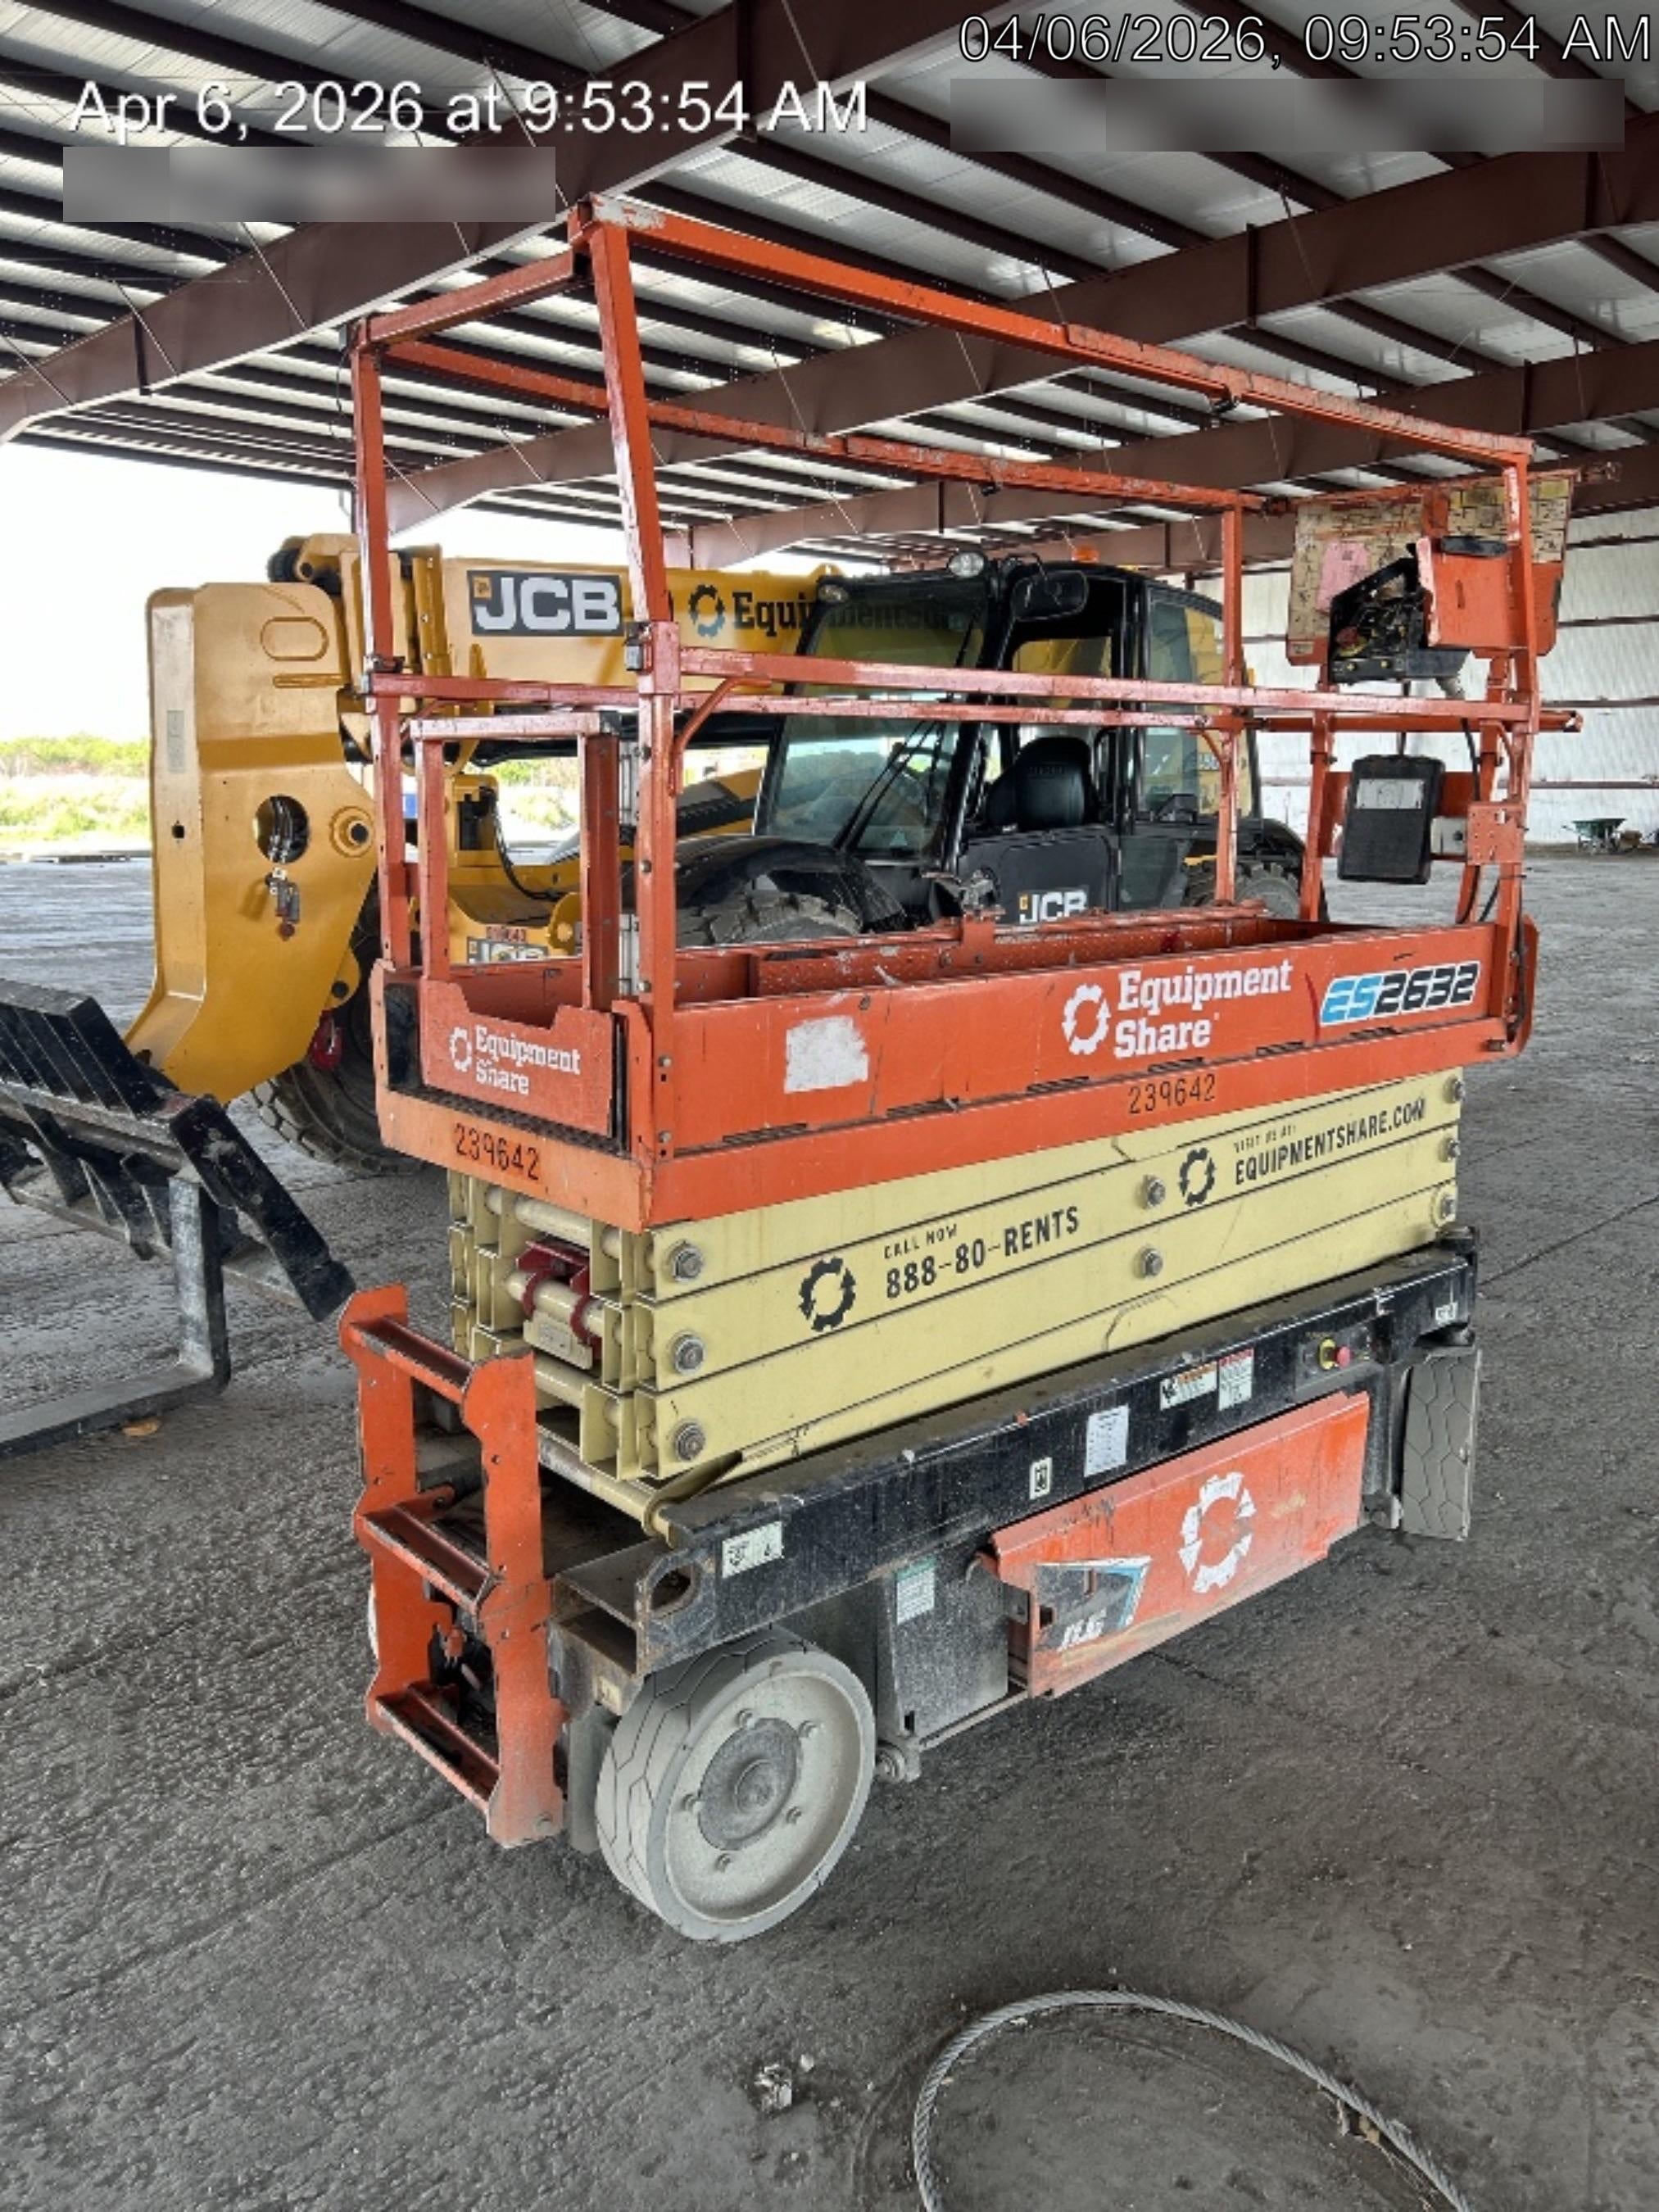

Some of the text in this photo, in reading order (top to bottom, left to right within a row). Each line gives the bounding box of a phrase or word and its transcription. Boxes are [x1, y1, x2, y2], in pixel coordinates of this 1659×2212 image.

[473, 576, 621, 632] JCB
[1019, 889, 1088, 924] JCB
[1117, 957, 1294, 1016] Equipment
[1320, 960, 1481, 1027] ES2632
[474, 1024, 582, 1075] Equipment
[1113, 1017, 1212, 1060] Share
[475, 1057, 529, 1096] Share
[1127, 1072, 1216, 1115] 239642
[453, 1122, 540, 1181] 239642
[1235, 1097, 1426, 1185] EQUIPMENTSHARE.COM
[884, 1223, 959, 1260] CALL NOW
[886, 1205, 1081, 1299] 888-80-RENTS
